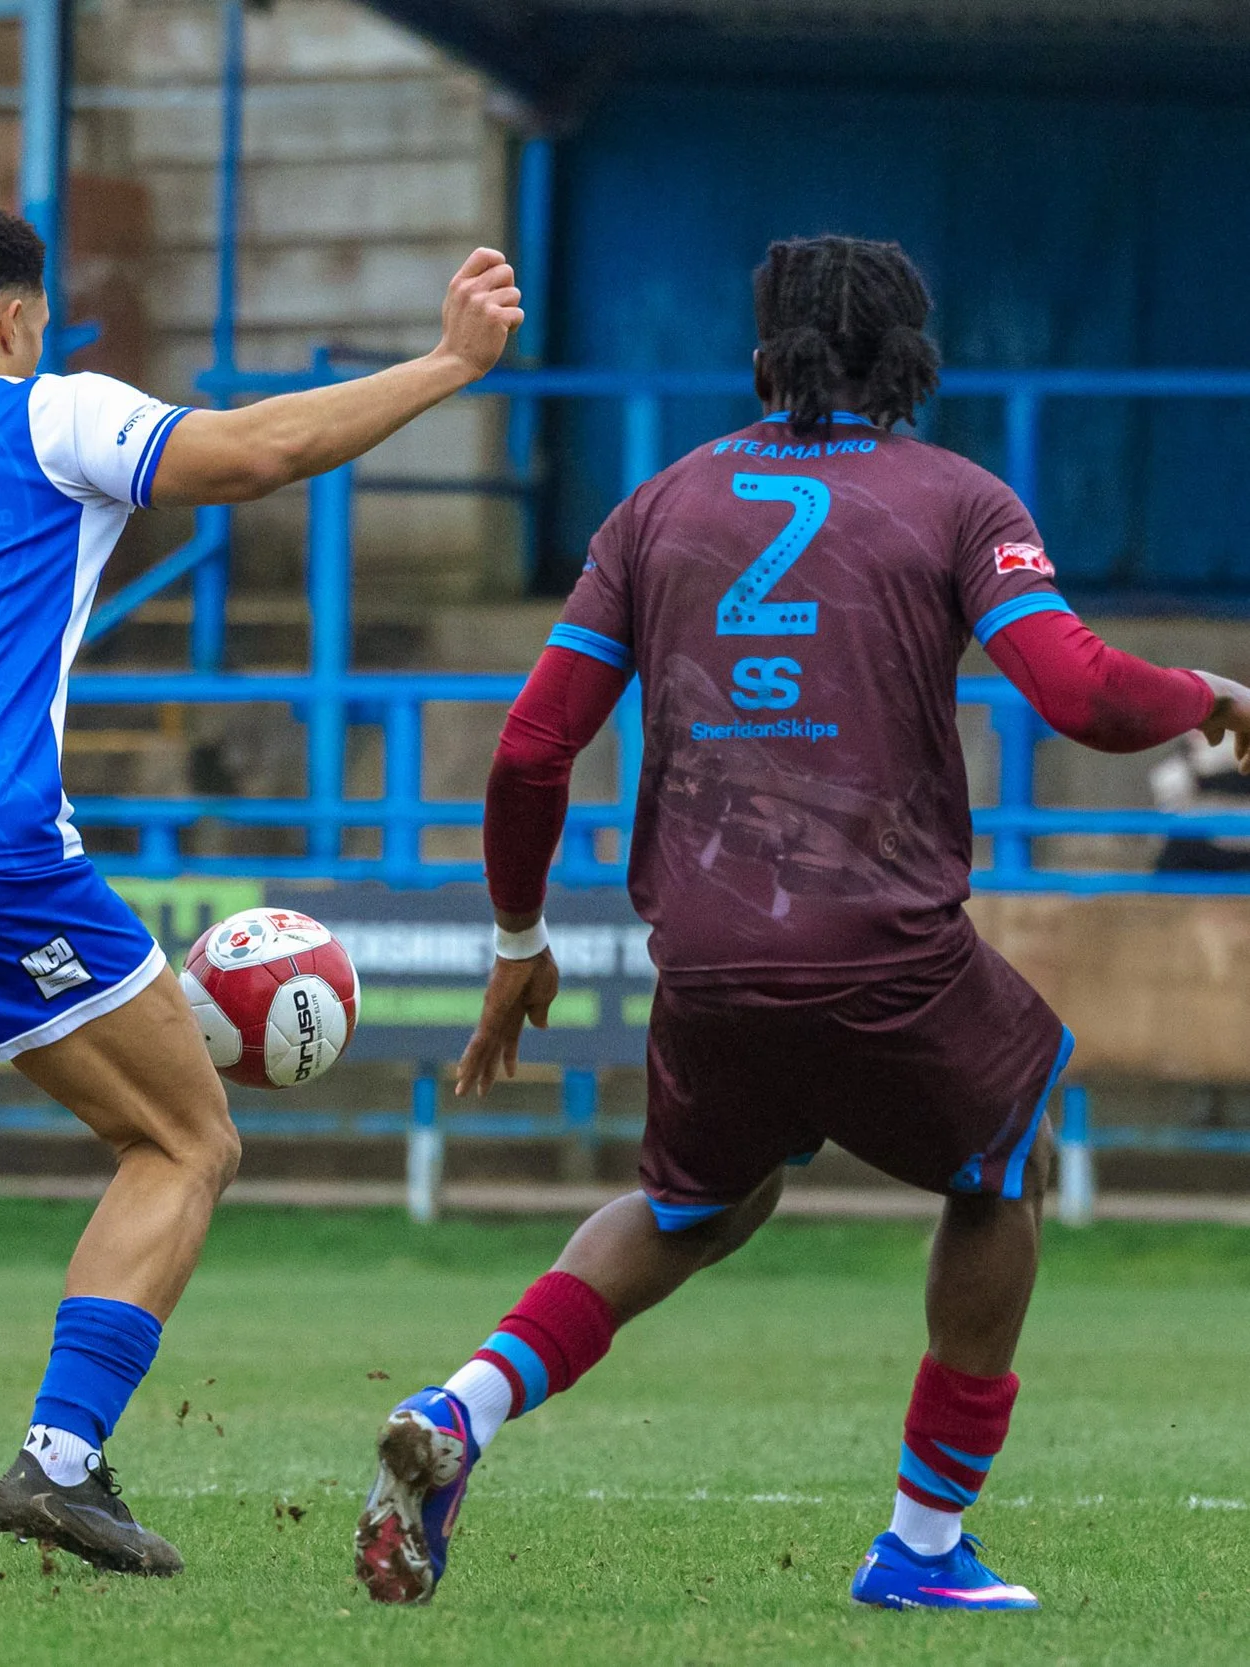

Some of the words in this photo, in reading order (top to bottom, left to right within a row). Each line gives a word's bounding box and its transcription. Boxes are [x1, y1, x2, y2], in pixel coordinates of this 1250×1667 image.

[711, 438, 878, 460] #TEAMAVRO
[716, 472, 831, 636] 2
[730, 656, 802, 710] SS
[691, 717, 838, 742] SheridanSkips
[20, 937, 75, 977] MCD
[293, 990, 316, 1083] chryso
